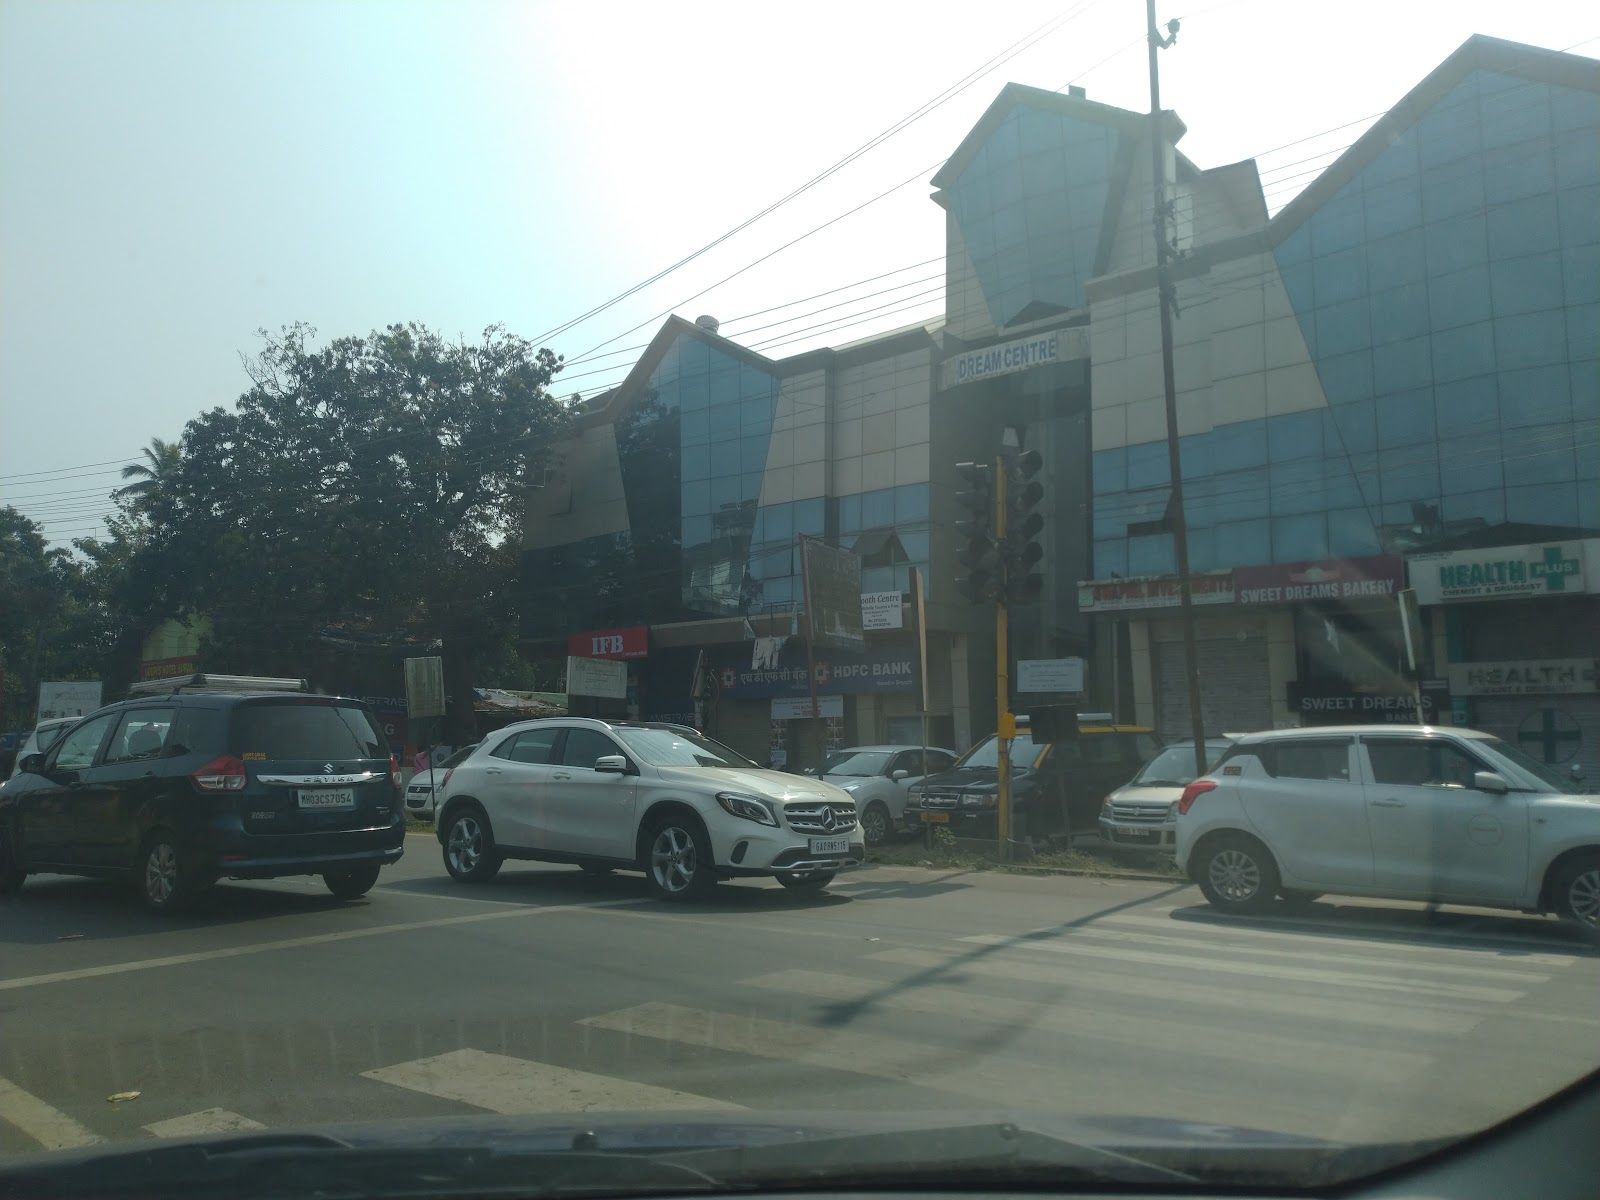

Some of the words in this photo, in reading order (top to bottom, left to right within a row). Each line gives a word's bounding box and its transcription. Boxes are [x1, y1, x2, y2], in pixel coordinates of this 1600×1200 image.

[959, 350, 1002, 378] DREAM
[1004, 338, 1056, 369] CENTRE
[1440, 560, 1526, 588] HEALTH
[1536, 562, 1573, 574] PLUS
[1240, 588, 1281, 604] SWEET
[1285, 582, 1338, 600] DREAMS
[1342, 579, 1394, 597] BAKERY
[1442, 587, 1481, 596] CHEMIST
[1494, 583, 1542, 592] DRUGGIST
[877, 594, 900, 603] Centre
[592, 635, 624, 655] IFB
[833, 664, 868, 678] HDFC
[872, 661, 911, 676] BANK
[1467, 667, 1574, 687] HEALTH
[350, 695, 408, 706] MSTRAD
[1302, 697, 1355, 710] SWEET
[1385, 712, 1431, 722] BAKEY
[301, 793, 352, 805] MH03CS7054
